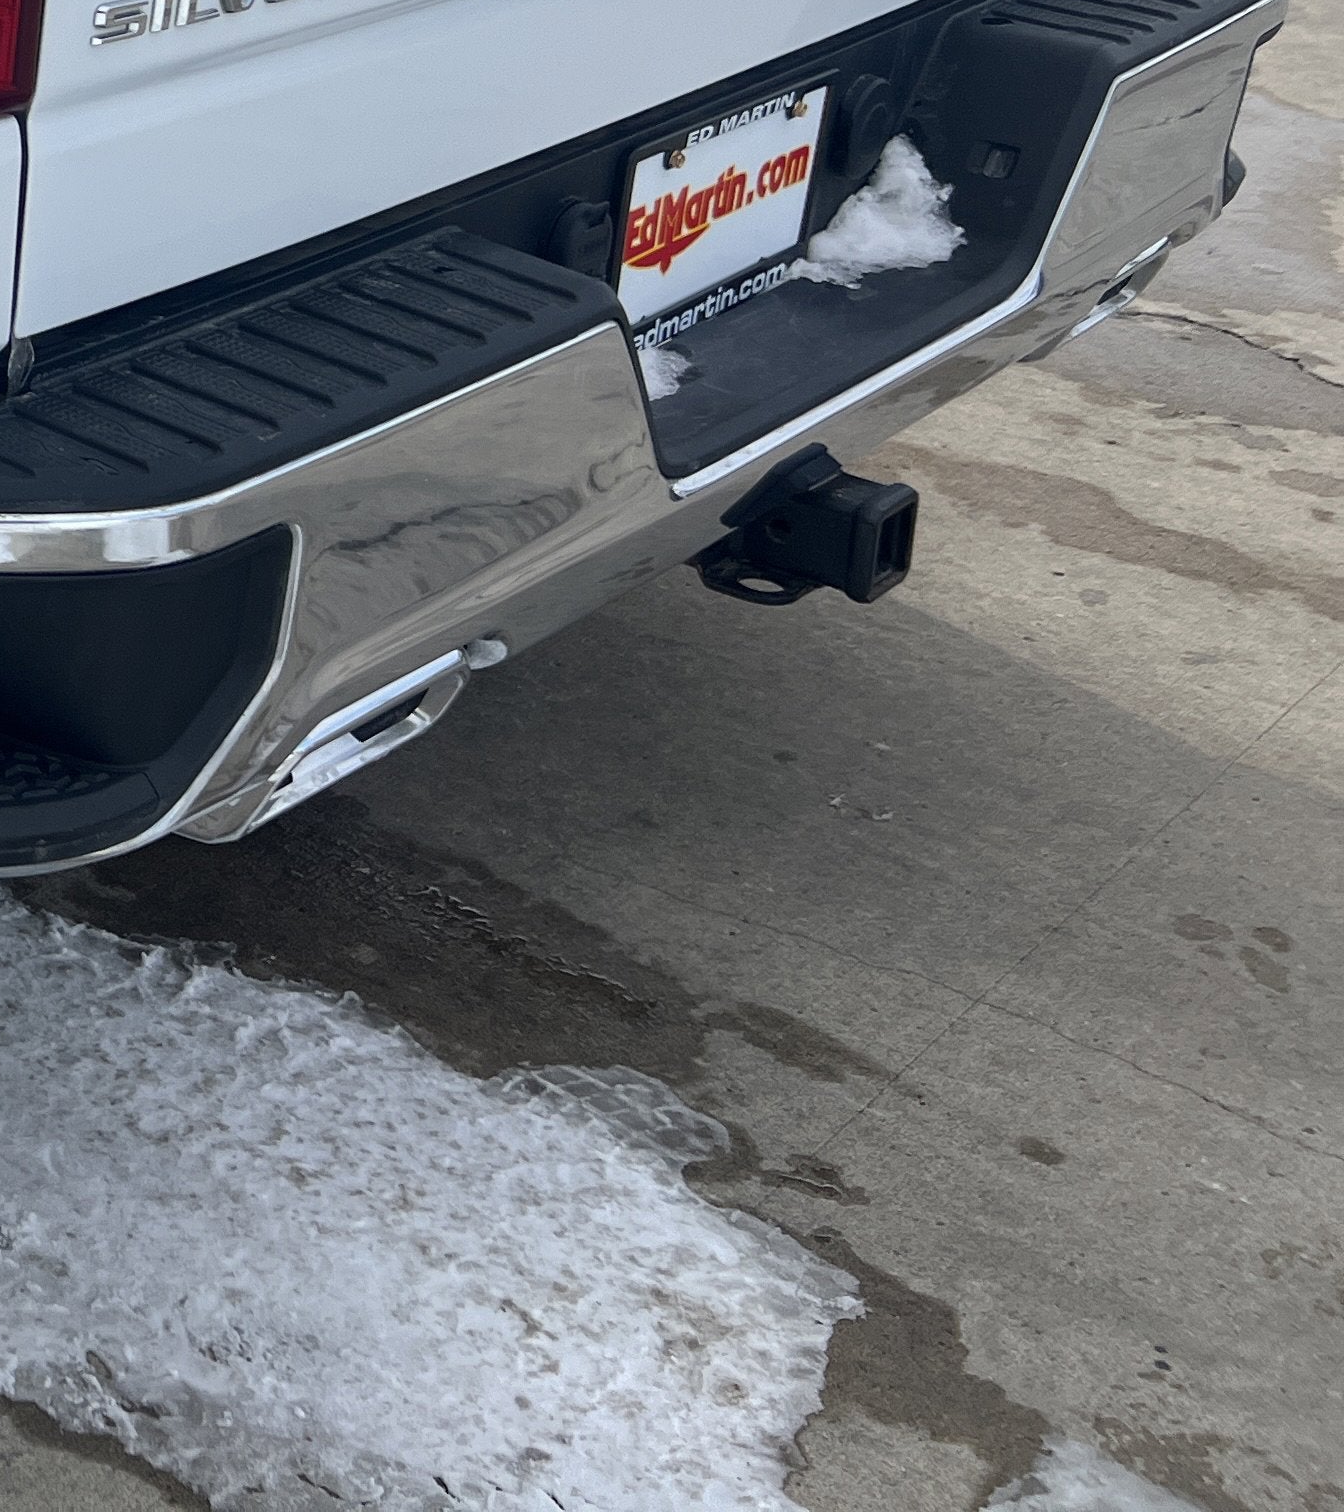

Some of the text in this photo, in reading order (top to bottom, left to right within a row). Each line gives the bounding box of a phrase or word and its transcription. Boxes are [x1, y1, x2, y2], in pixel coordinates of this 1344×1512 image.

[686, 91, 796, 149] ED MARTIN
[625, 144, 811, 258] EdMartin.com
